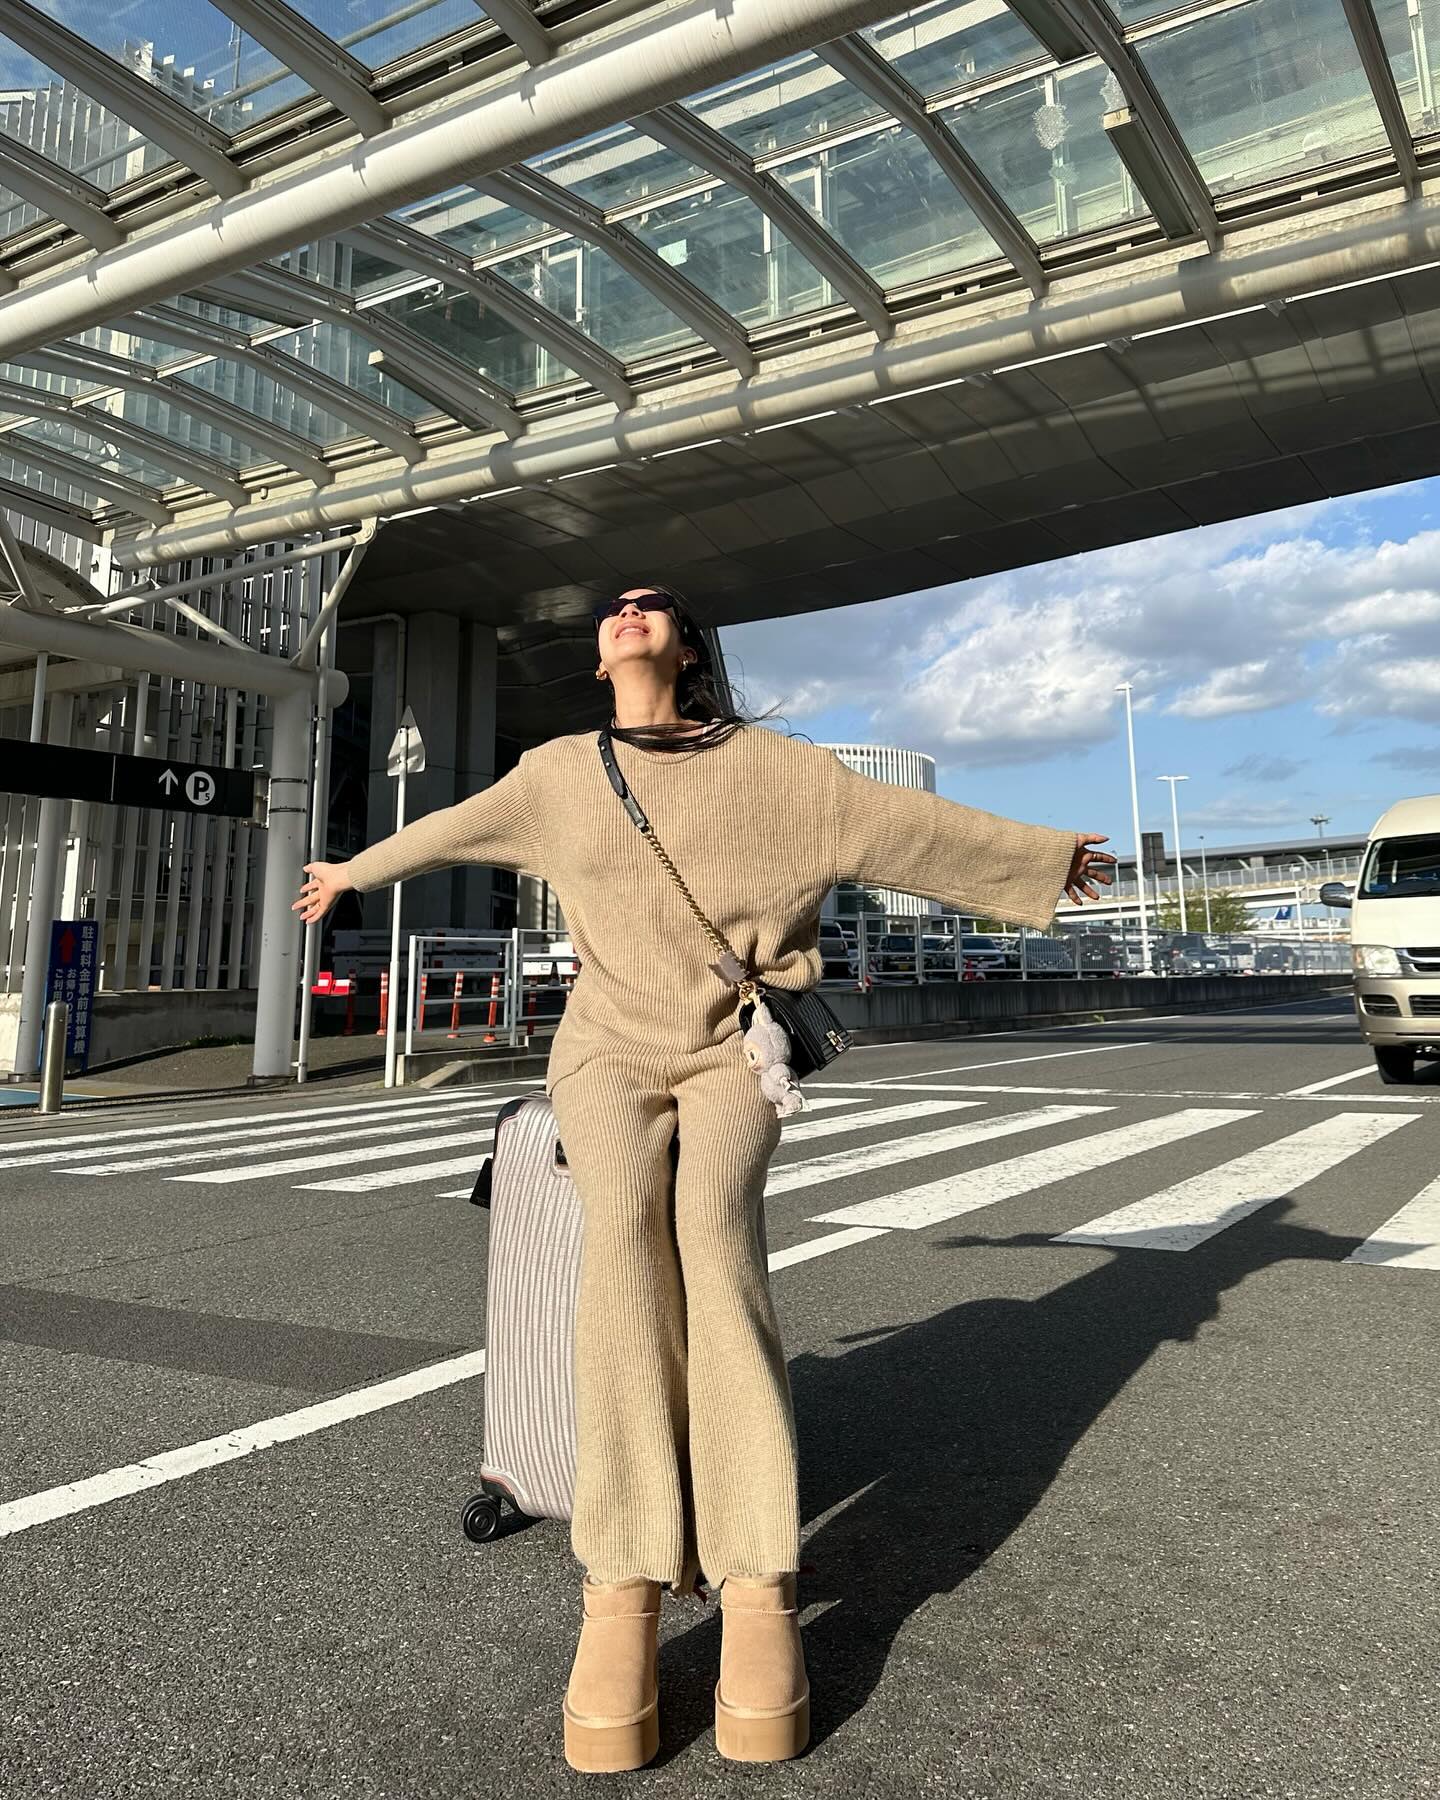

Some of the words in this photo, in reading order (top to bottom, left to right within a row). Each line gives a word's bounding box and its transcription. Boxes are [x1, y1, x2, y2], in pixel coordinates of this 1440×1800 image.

[73, 925, 94, 1054] 駐車料金事前精算機
